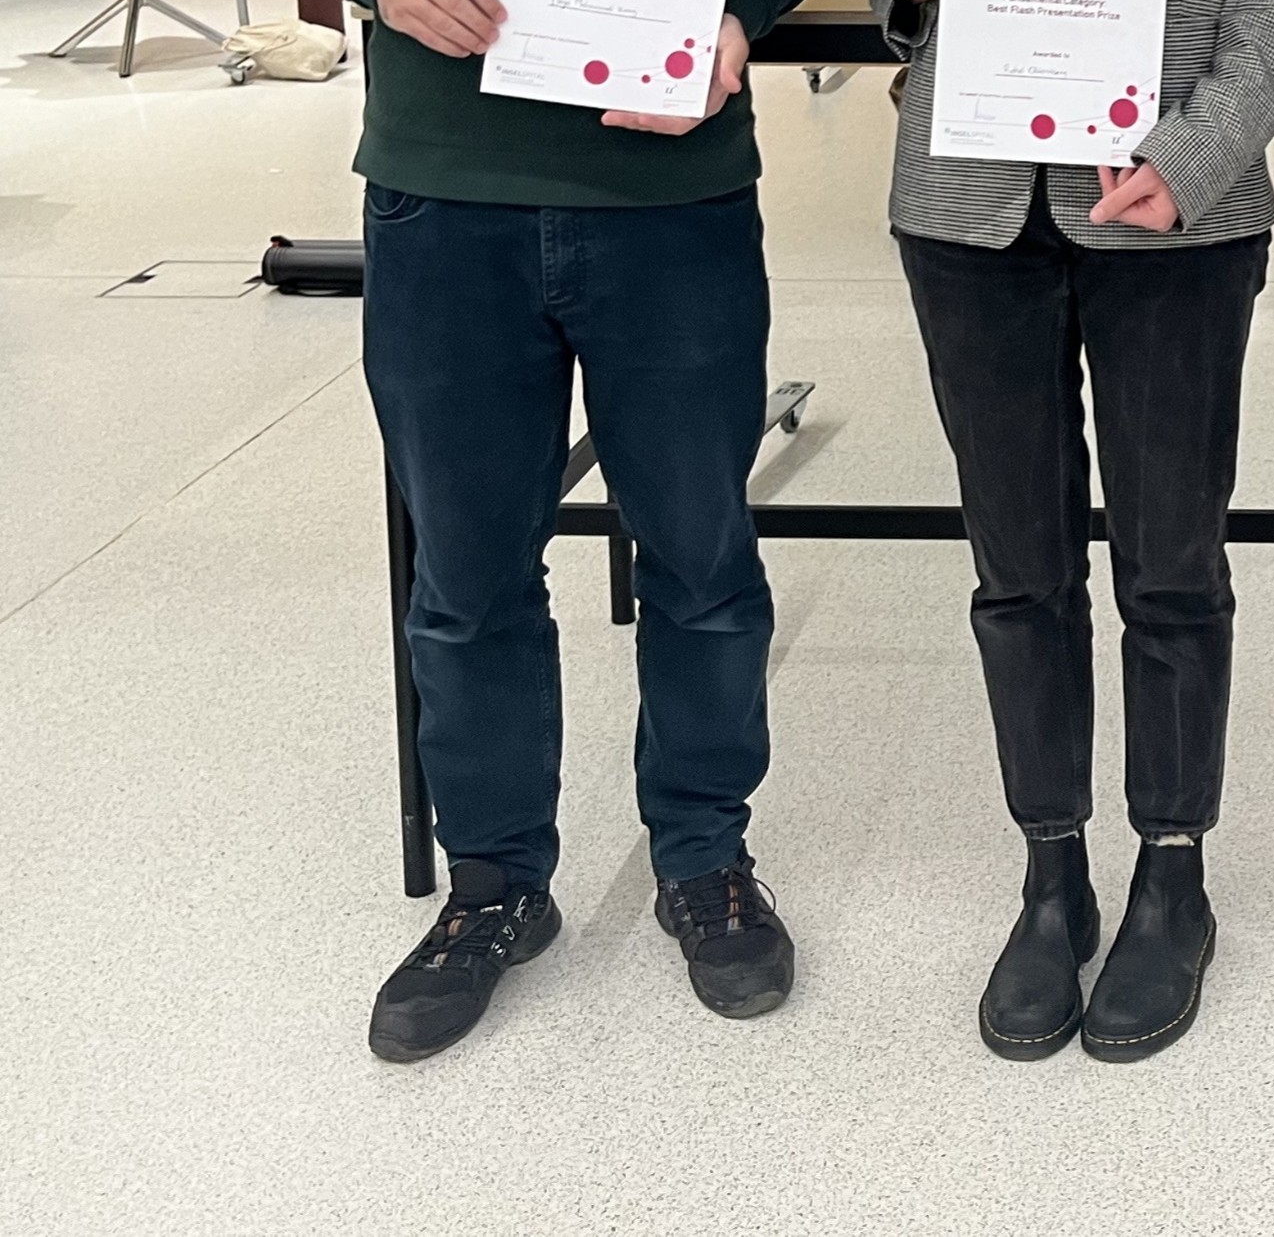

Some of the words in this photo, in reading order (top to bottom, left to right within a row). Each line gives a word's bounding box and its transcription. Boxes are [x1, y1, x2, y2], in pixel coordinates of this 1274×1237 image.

[987, 4, 1008, 13] Best
[1010, 5, 1035, 14] Flash
[1037, 7, 1094, 18] Presentation
[1097, 11, 1120, 20] Prize
